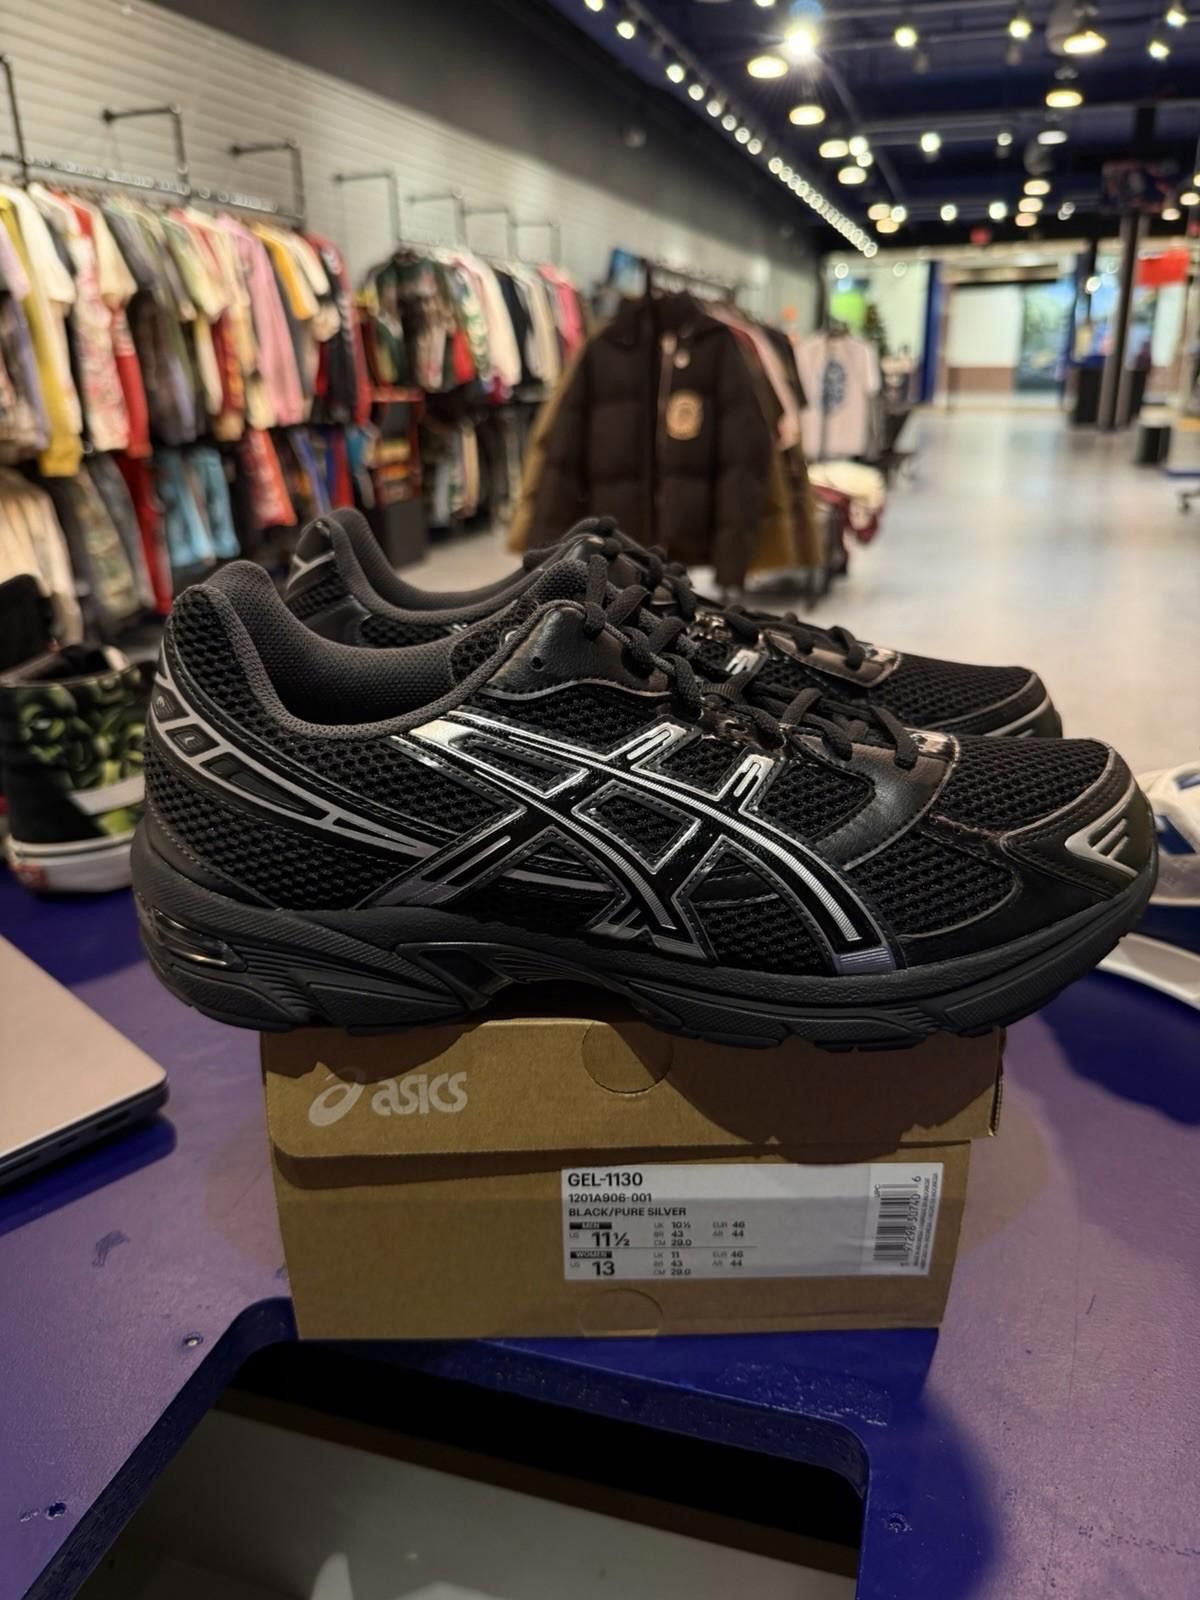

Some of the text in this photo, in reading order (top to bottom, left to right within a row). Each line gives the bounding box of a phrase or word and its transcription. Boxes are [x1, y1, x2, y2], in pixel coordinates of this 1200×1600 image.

[371, 1072, 468, 1116] asics
[568, 1172, 643, 1187] GEL-1130
[911, 1175, 922, 1183] 6
[568, 1192, 652, 1203] 1201A906-001
[568, 1207, 687, 1217] BLACK/PURE SILVER
[731, 1230, 744, 1238] 44
[730, 1259, 743, 1267] 44
[592, 1261, 615, 1276] 13
